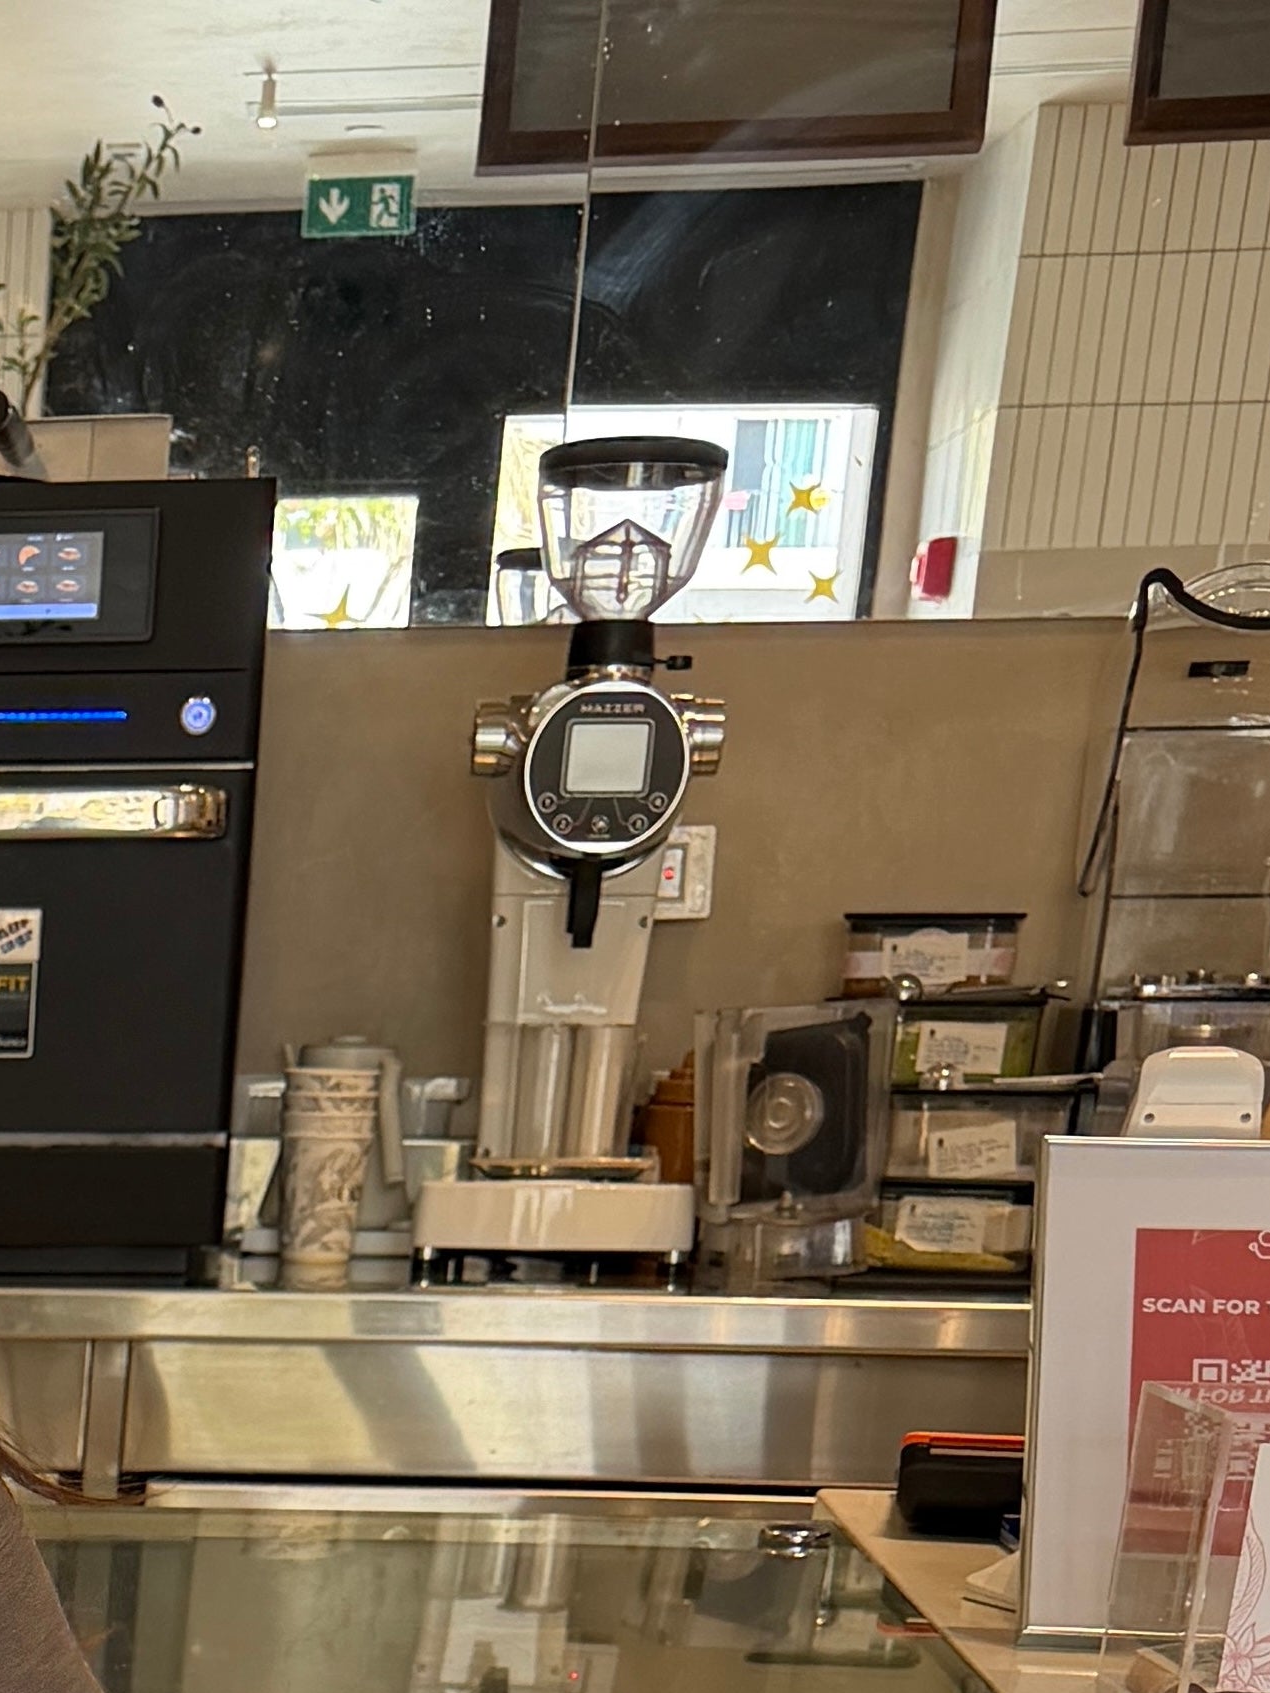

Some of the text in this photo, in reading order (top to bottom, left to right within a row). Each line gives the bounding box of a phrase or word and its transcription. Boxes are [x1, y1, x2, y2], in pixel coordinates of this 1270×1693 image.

[579, 703, 646, 714] MAZZER
[1141, 1297, 1206, 1315] SCAN
[1212, 1299, 1261, 1316] FOR
